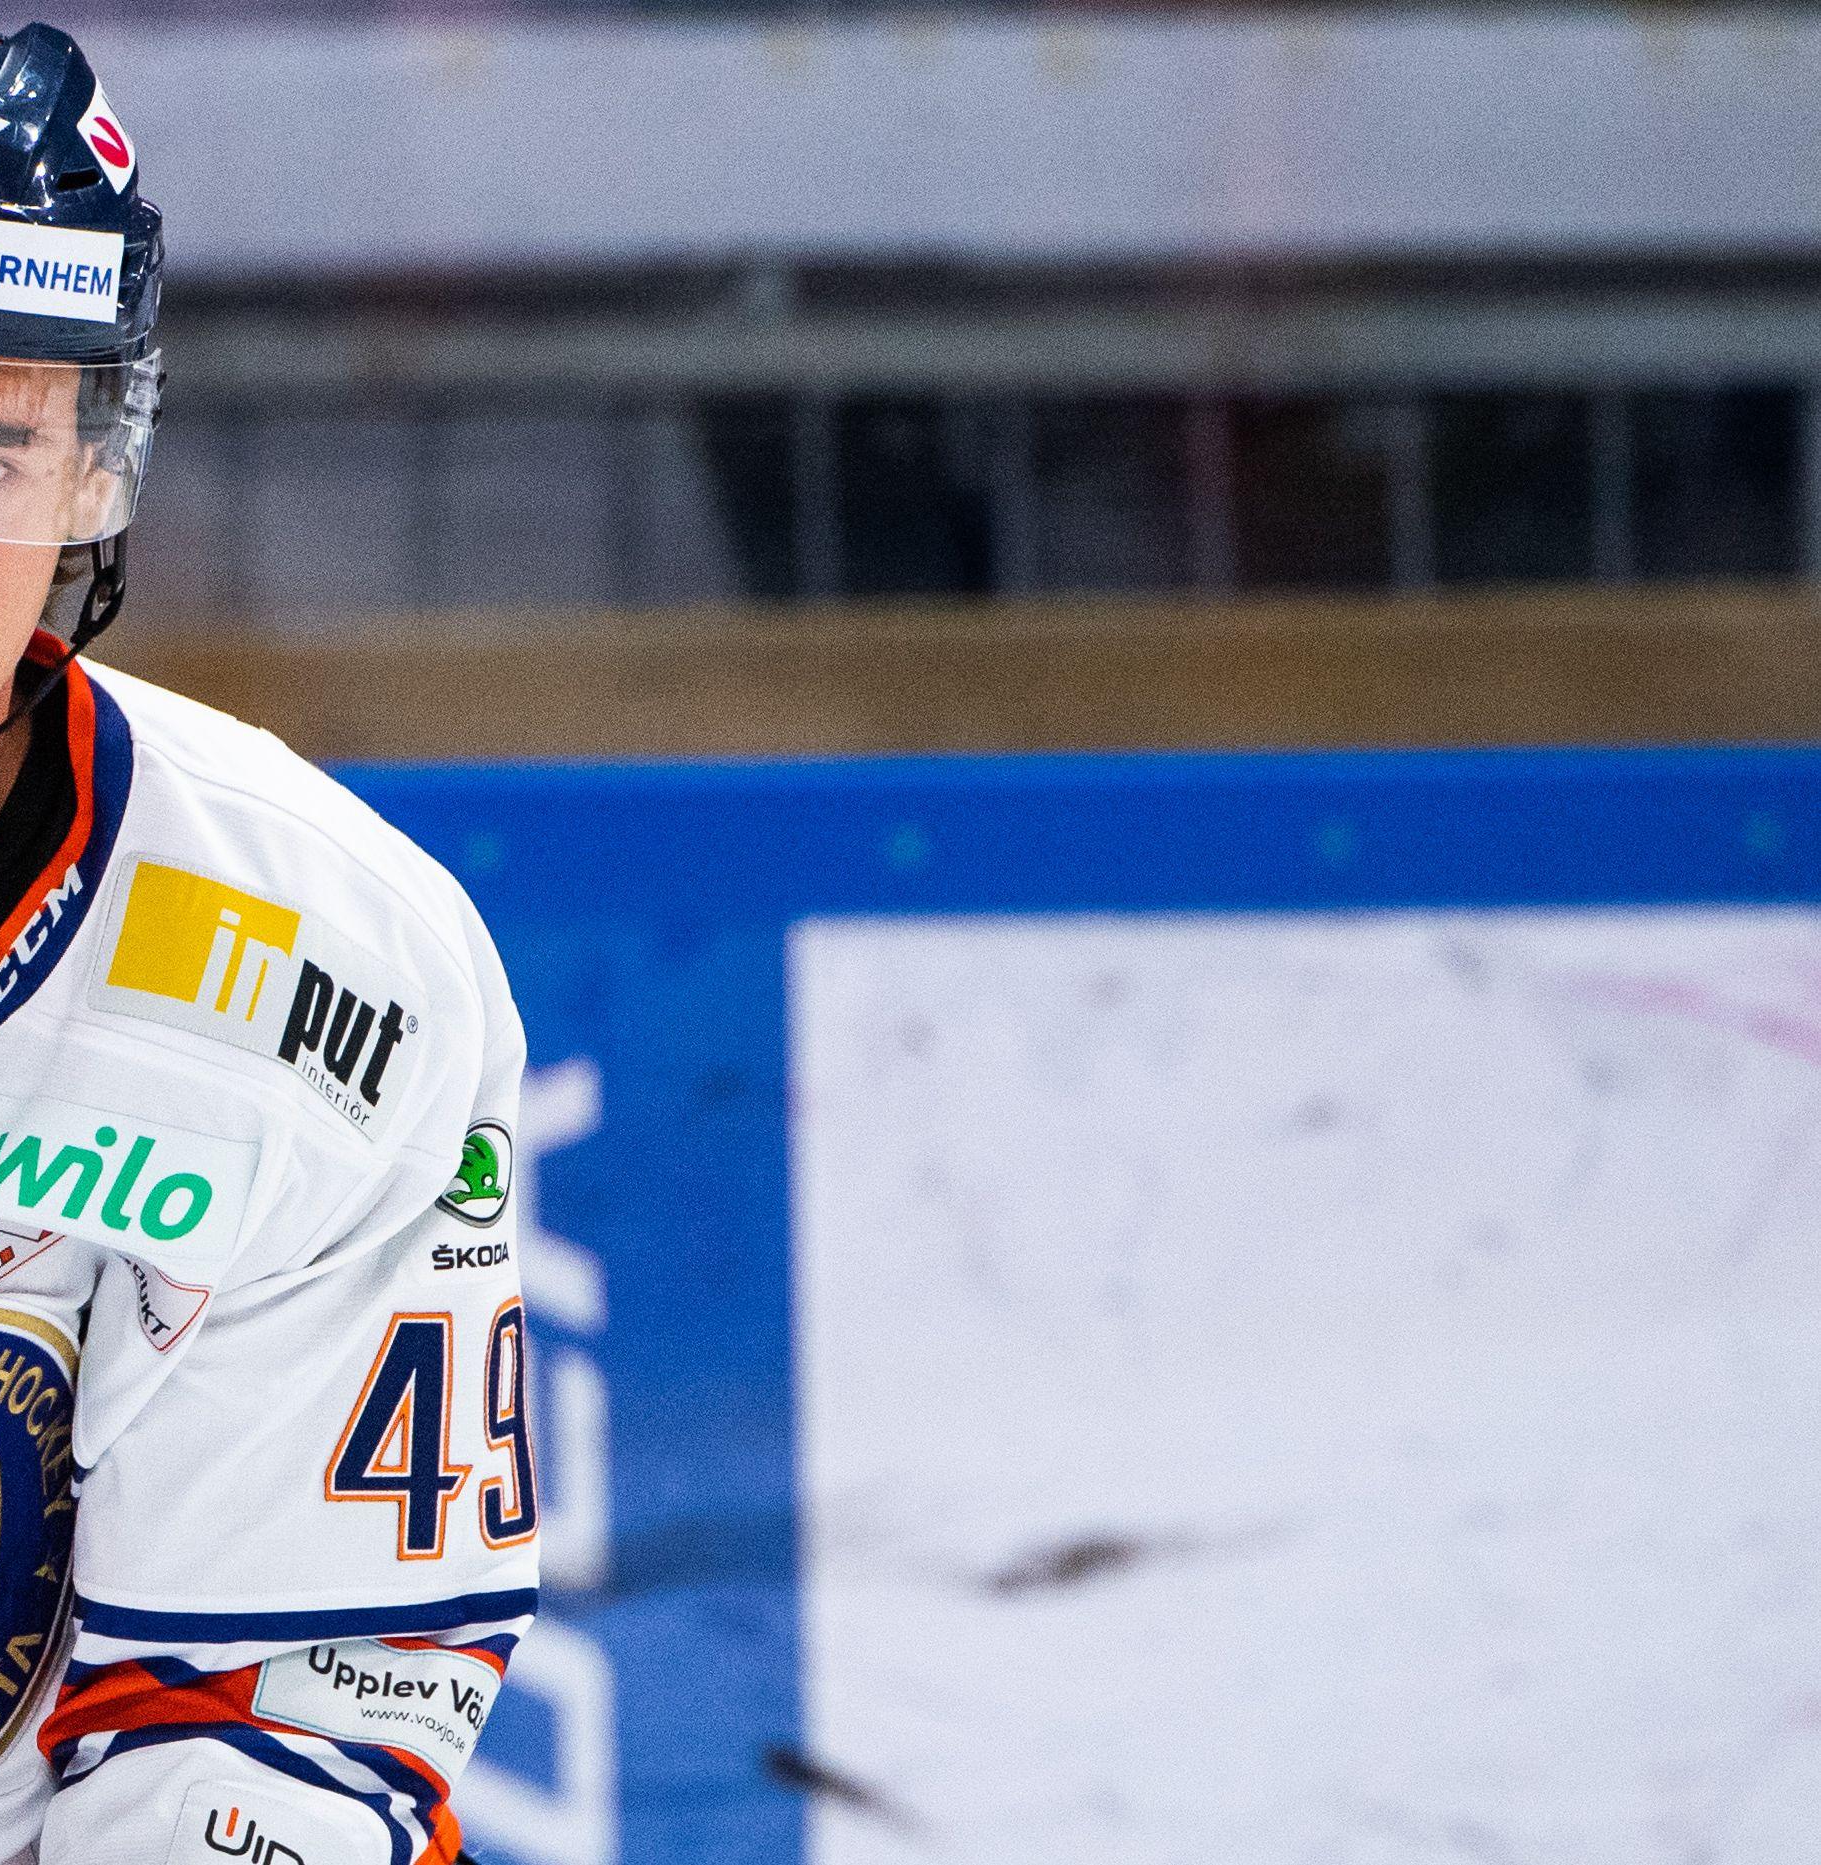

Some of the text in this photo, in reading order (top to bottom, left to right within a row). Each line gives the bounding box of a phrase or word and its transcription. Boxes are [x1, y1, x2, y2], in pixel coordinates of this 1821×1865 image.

[301, 1054, 371, 1128] interiör
[432, 1241, 510, 1271] ŠKODA
[324, 1295, 540, 1561] 49
[308, 1645, 439, 1699] Upplev
[360, 1707, 466, 1754] www.vaxjo.se
